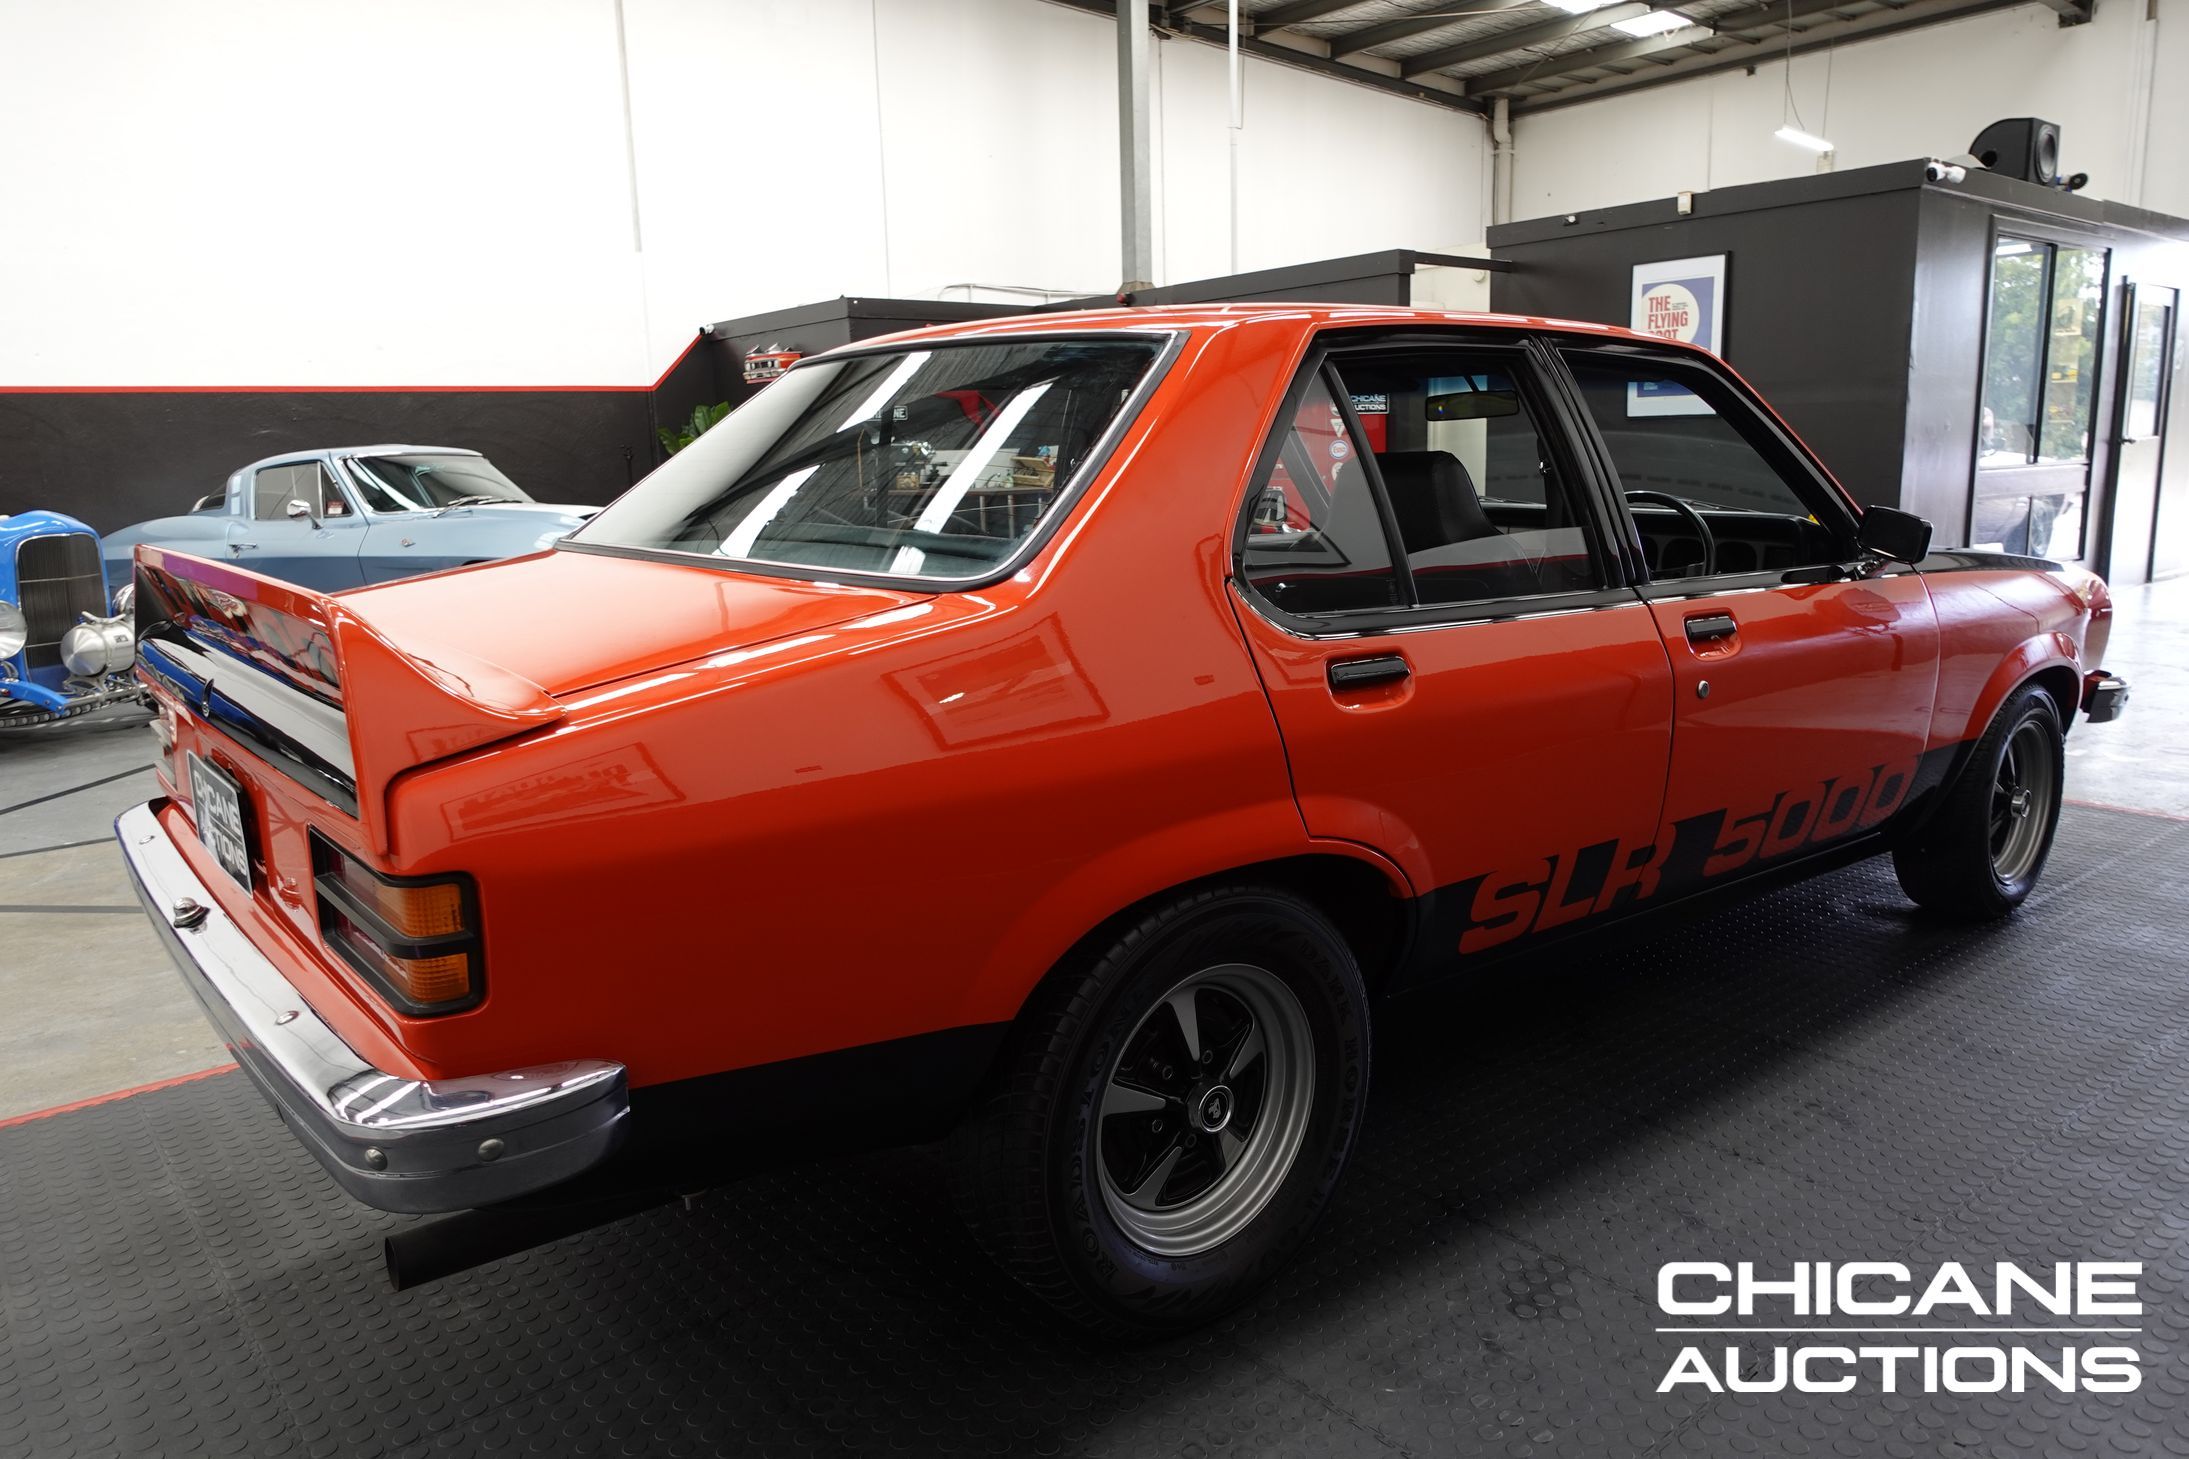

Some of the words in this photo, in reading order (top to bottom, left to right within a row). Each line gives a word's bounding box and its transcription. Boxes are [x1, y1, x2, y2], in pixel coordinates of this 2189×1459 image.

[1648, 296, 1671, 312] THE
[1648, 311, 1688, 329] FLYING
[1350, 394, 1387, 402] CHICANE
[1458, 822, 1676, 954] SLR
[1703, 757, 1918, 877] 5000
